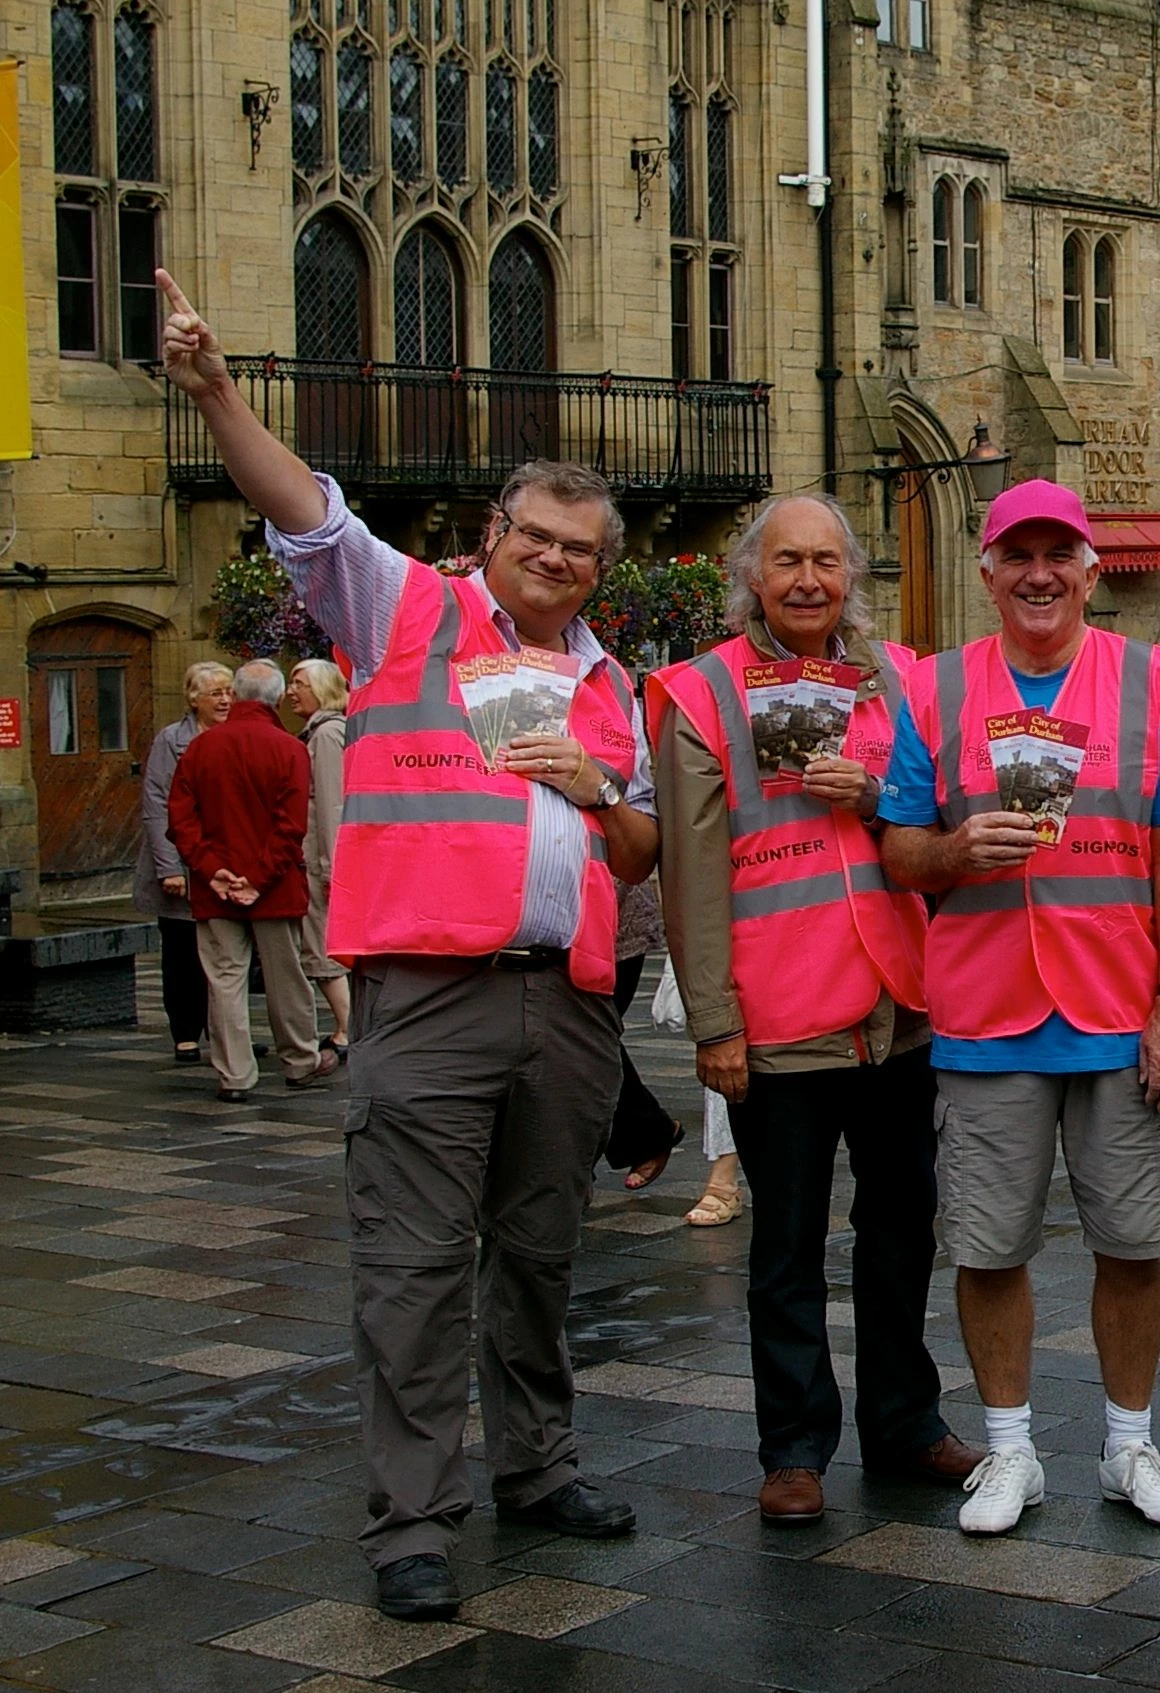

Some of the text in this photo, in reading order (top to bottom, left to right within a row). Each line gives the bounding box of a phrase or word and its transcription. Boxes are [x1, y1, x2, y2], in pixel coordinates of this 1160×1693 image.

[1081, 420, 1150, 446] RHAM
[1084, 450, 1146, 475] DOOR
[1085, 480, 1153, 504] ARKET
[524, 649, 541, 660] City
[521, 656, 556, 672] Durham
[746, 666, 774, 677] City of
[804, 660, 833, 673] City of
[747, 675, 782, 687] Durham
[803, 669, 836, 684] Durham
[988, 714, 1017, 729] City of
[1032, 715, 1061, 730] City of
[990, 725, 1026, 739] Durham
[1029, 725, 1064, 742] Durham
[730, 839, 826, 870] VOLUNTEER
